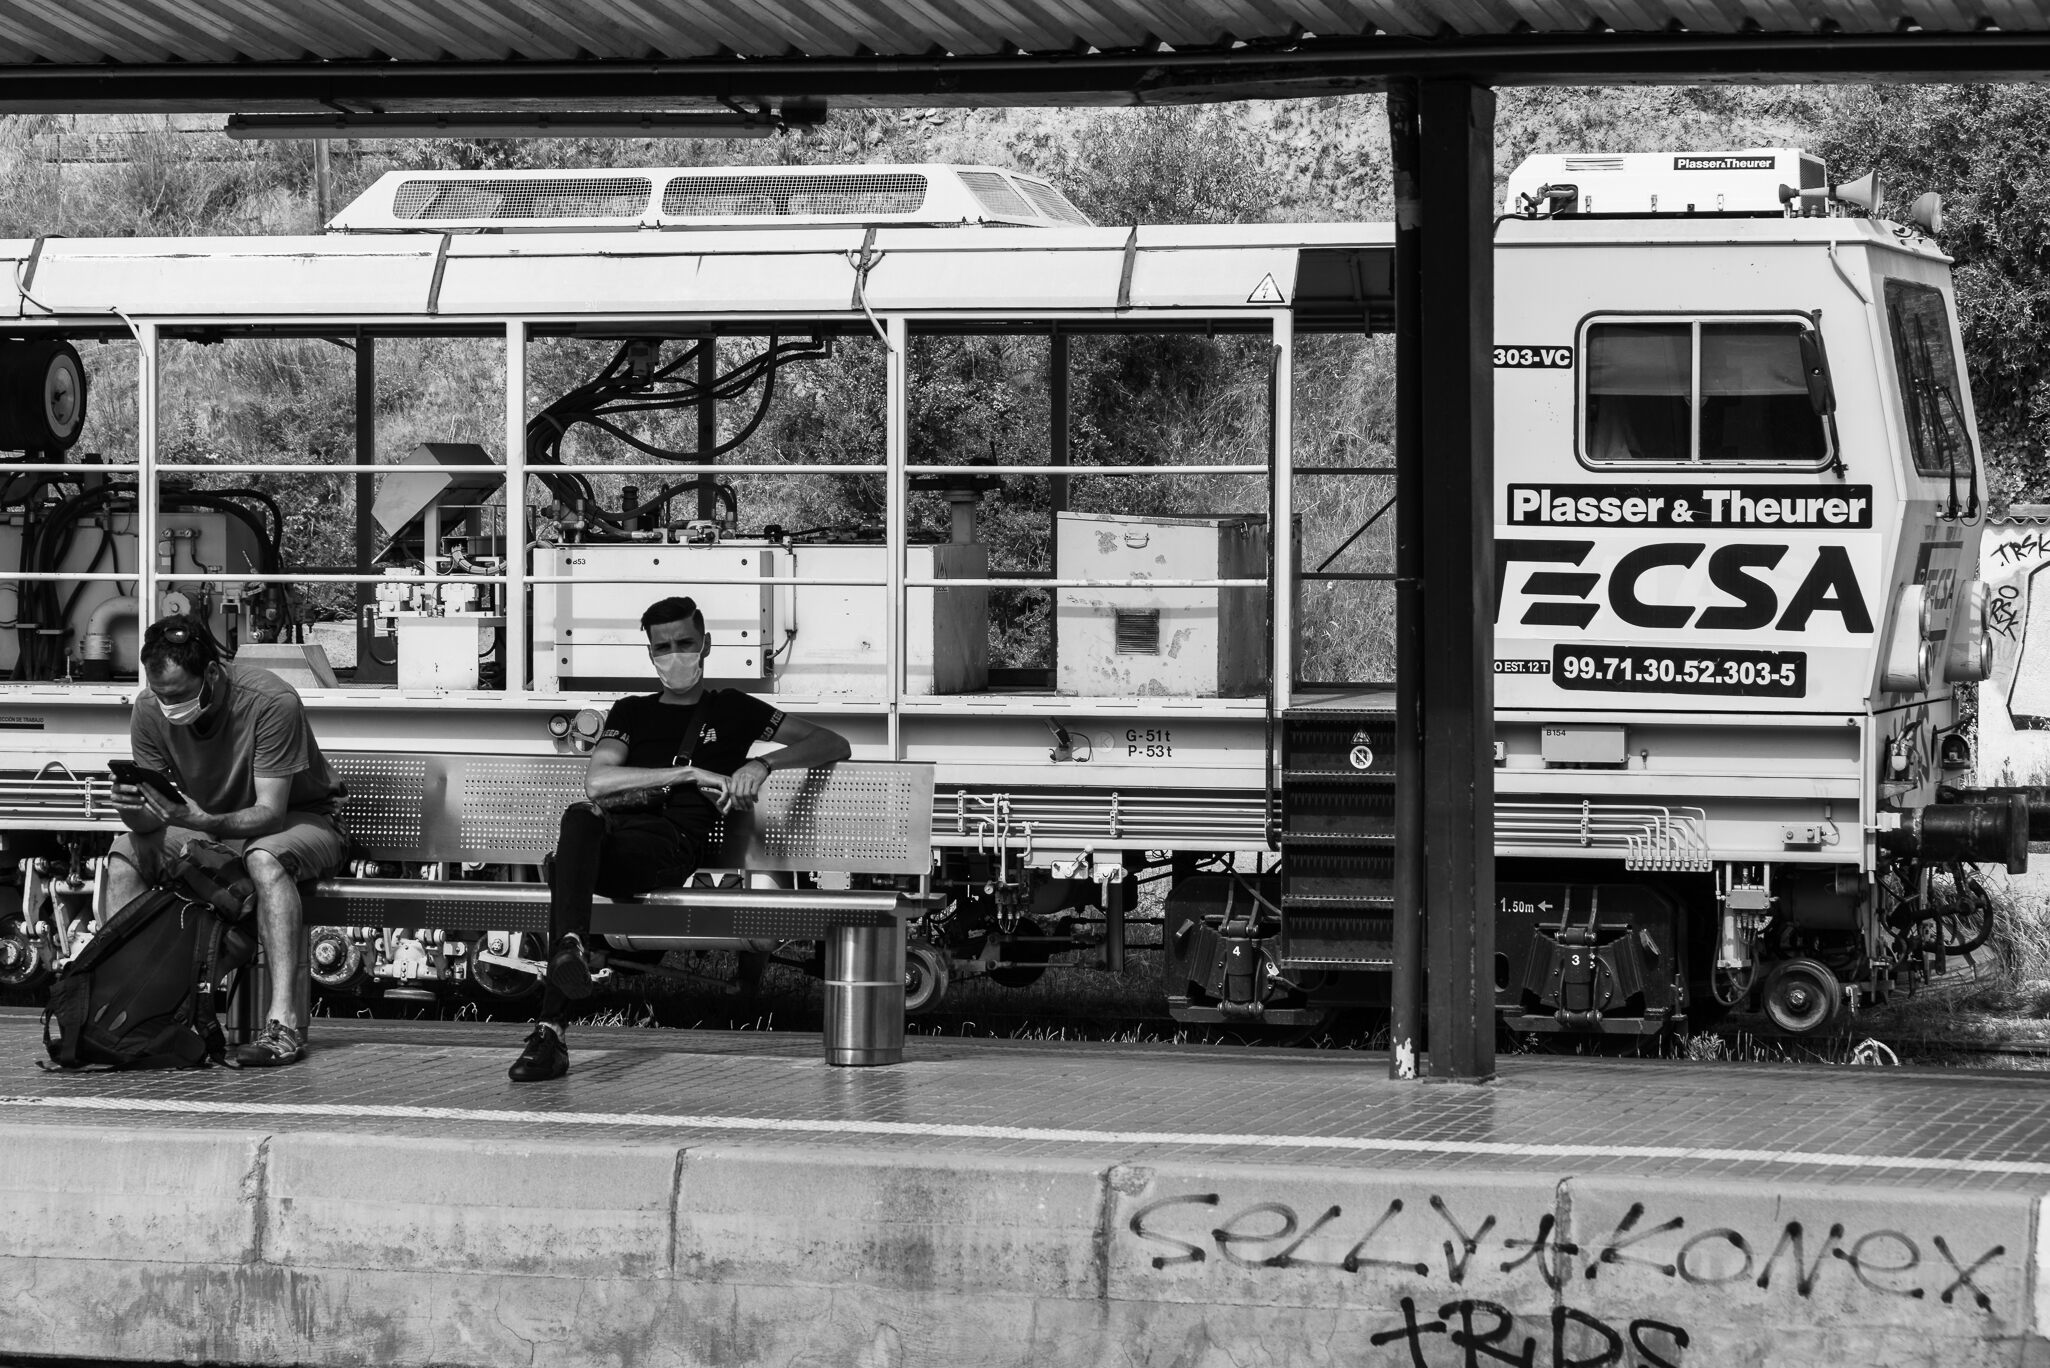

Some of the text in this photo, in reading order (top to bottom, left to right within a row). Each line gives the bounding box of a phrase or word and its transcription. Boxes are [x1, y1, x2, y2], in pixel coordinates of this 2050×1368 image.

[1494, 348, 1571, 366] 303-VC
[1512, 489, 1866, 523] Plasser & Theurer
[1504, 662, 1526, 672] EST.
[1527, 662, 1539, 672] 12
[1541, 662, 1548, 672] T
[1563, 656, 1796, 686] 99.71.30.52.303-5
[1500, 897, 1534, 913] 1.50m
[1232, 945, 1241, 957] 4
[1571, 954, 1580, 966] 3
